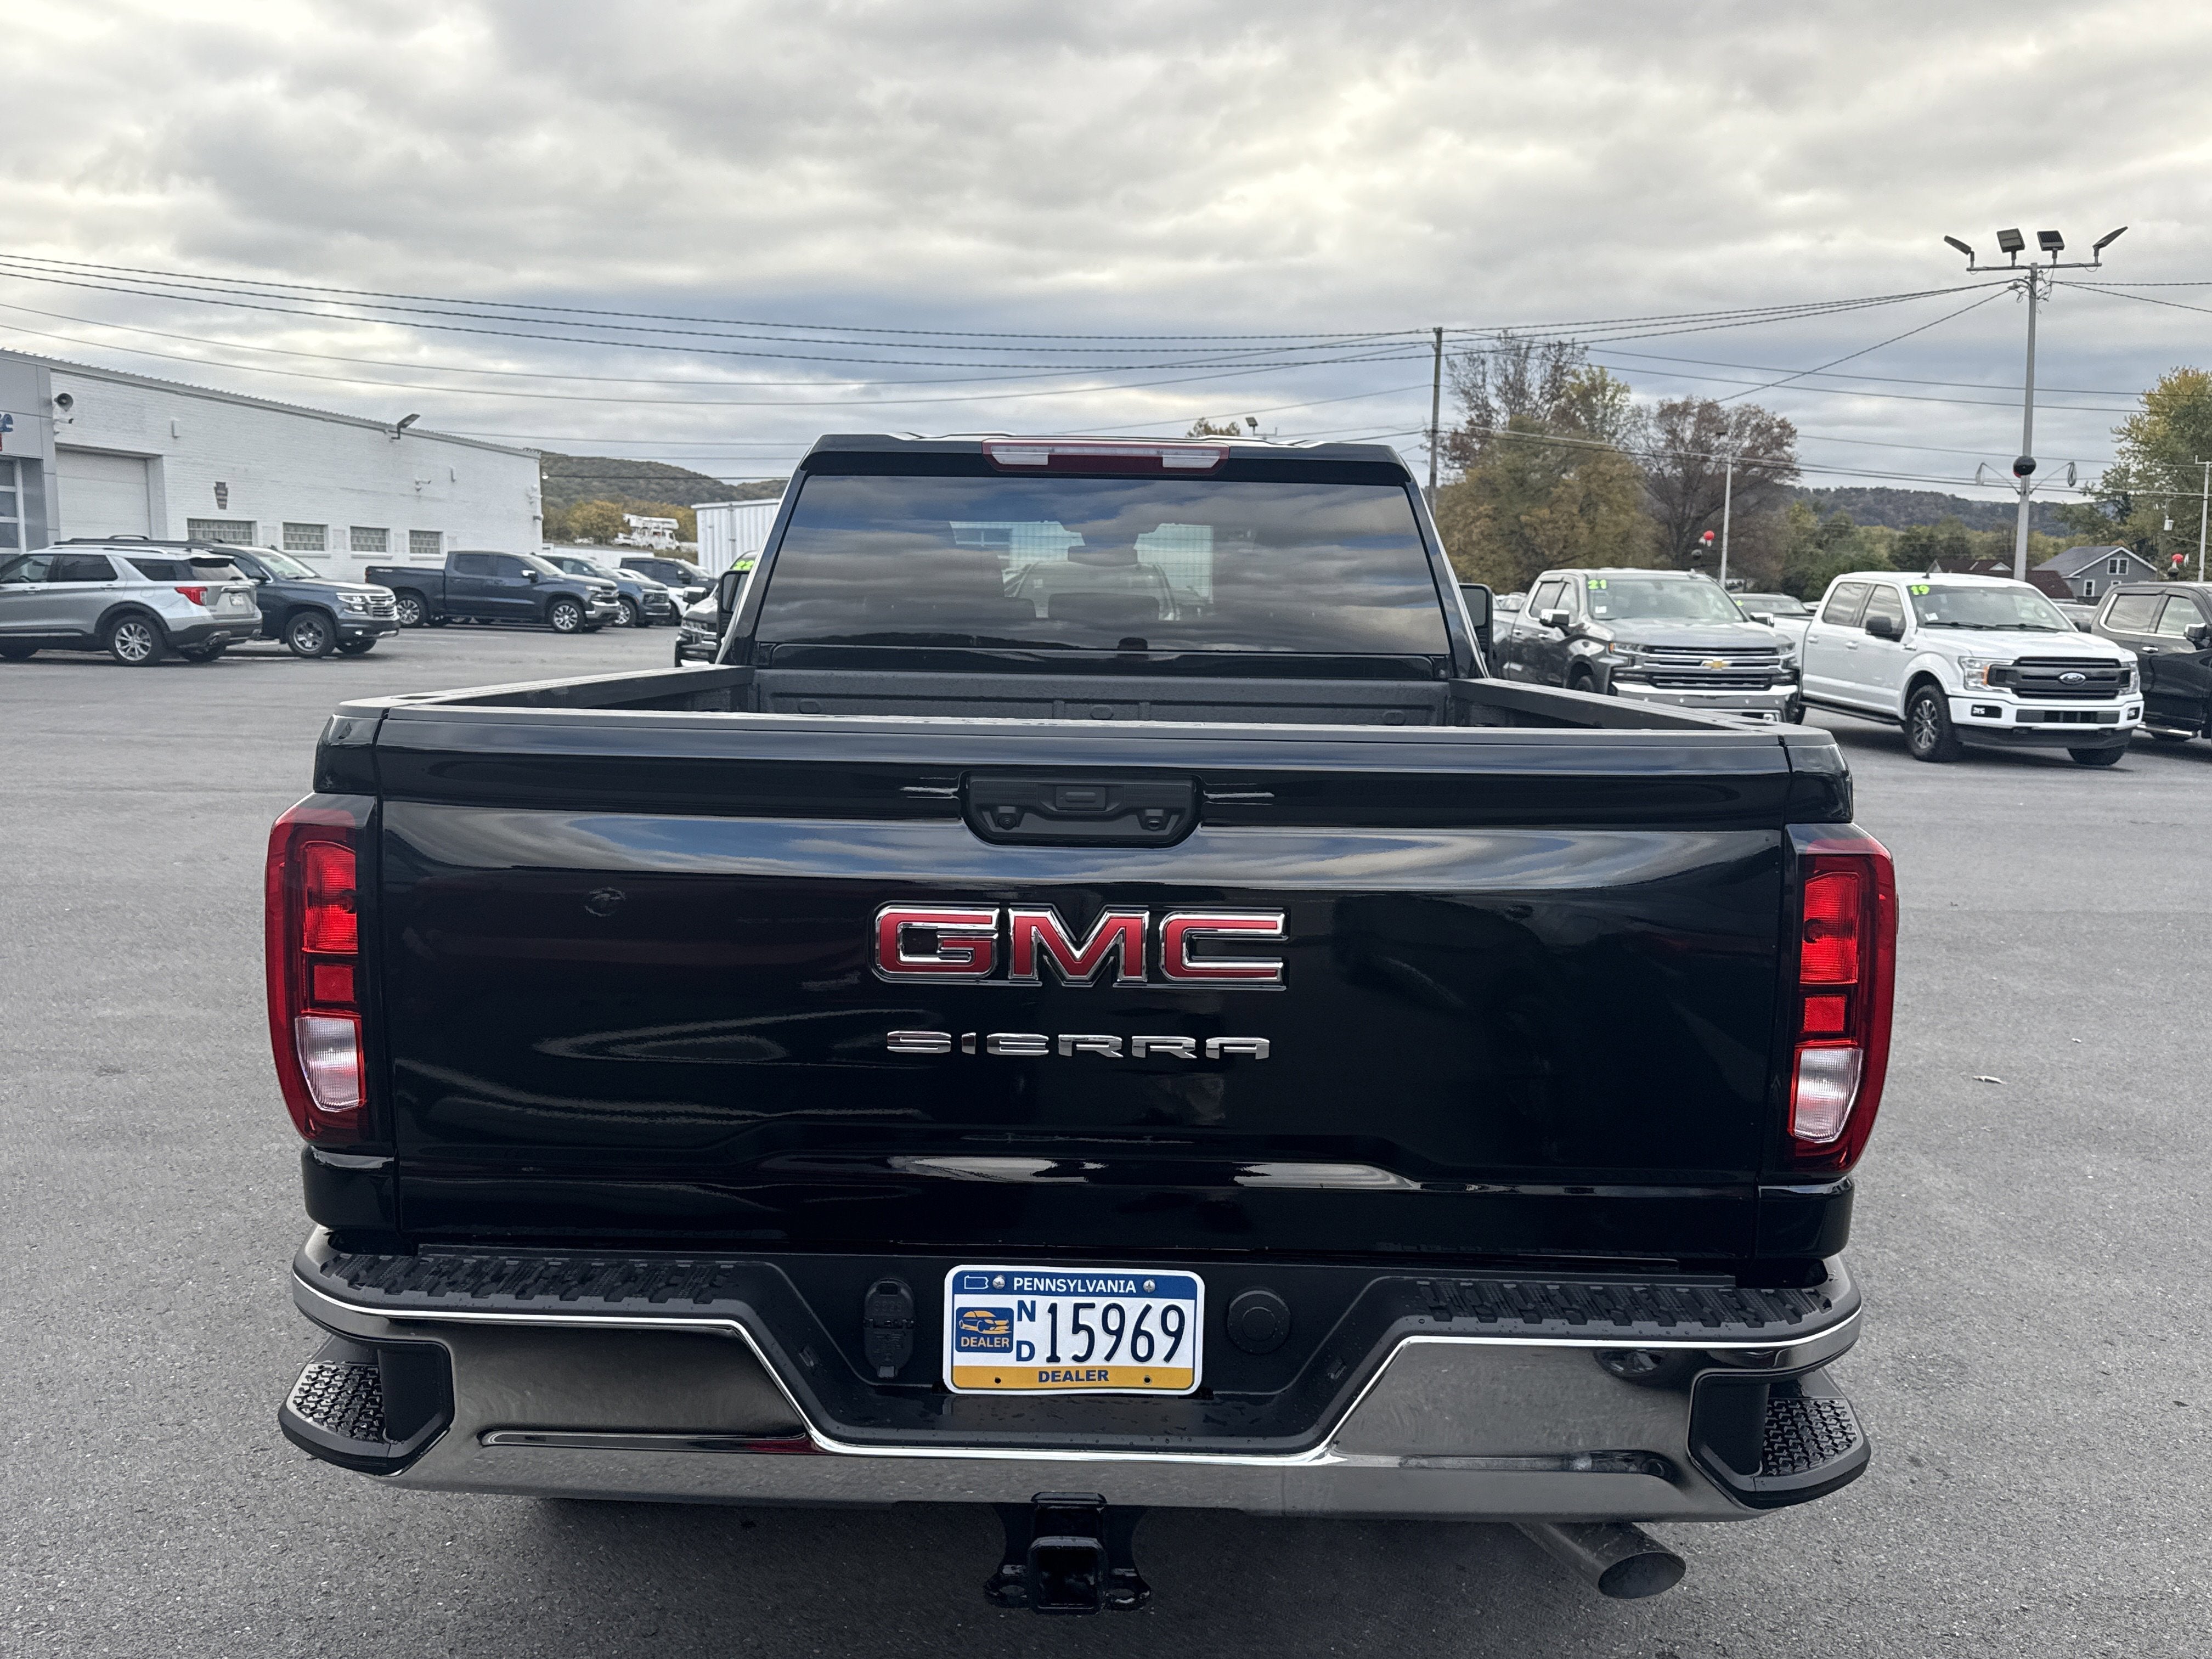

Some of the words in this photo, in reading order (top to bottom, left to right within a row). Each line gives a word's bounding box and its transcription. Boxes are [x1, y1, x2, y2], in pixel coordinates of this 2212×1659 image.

[1588, 579, 1607, 589] 21
[1911, 585, 1930, 596] 19
[872, 903, 1287, 988] GMC
[887, 1030, 1271, 1060] SIERRA
[1013, 1277, 1137, 1293] PENNSYLVANIA
[1017, 1300, 1036, 1322] N
[1046, 1302, 1186, 1363] 15969
[961, 1337, 1010, 1348] DEALER
[1015, 1340, 1036, 1362] D
[1038, 1370, 1109, 1383] DEALER
